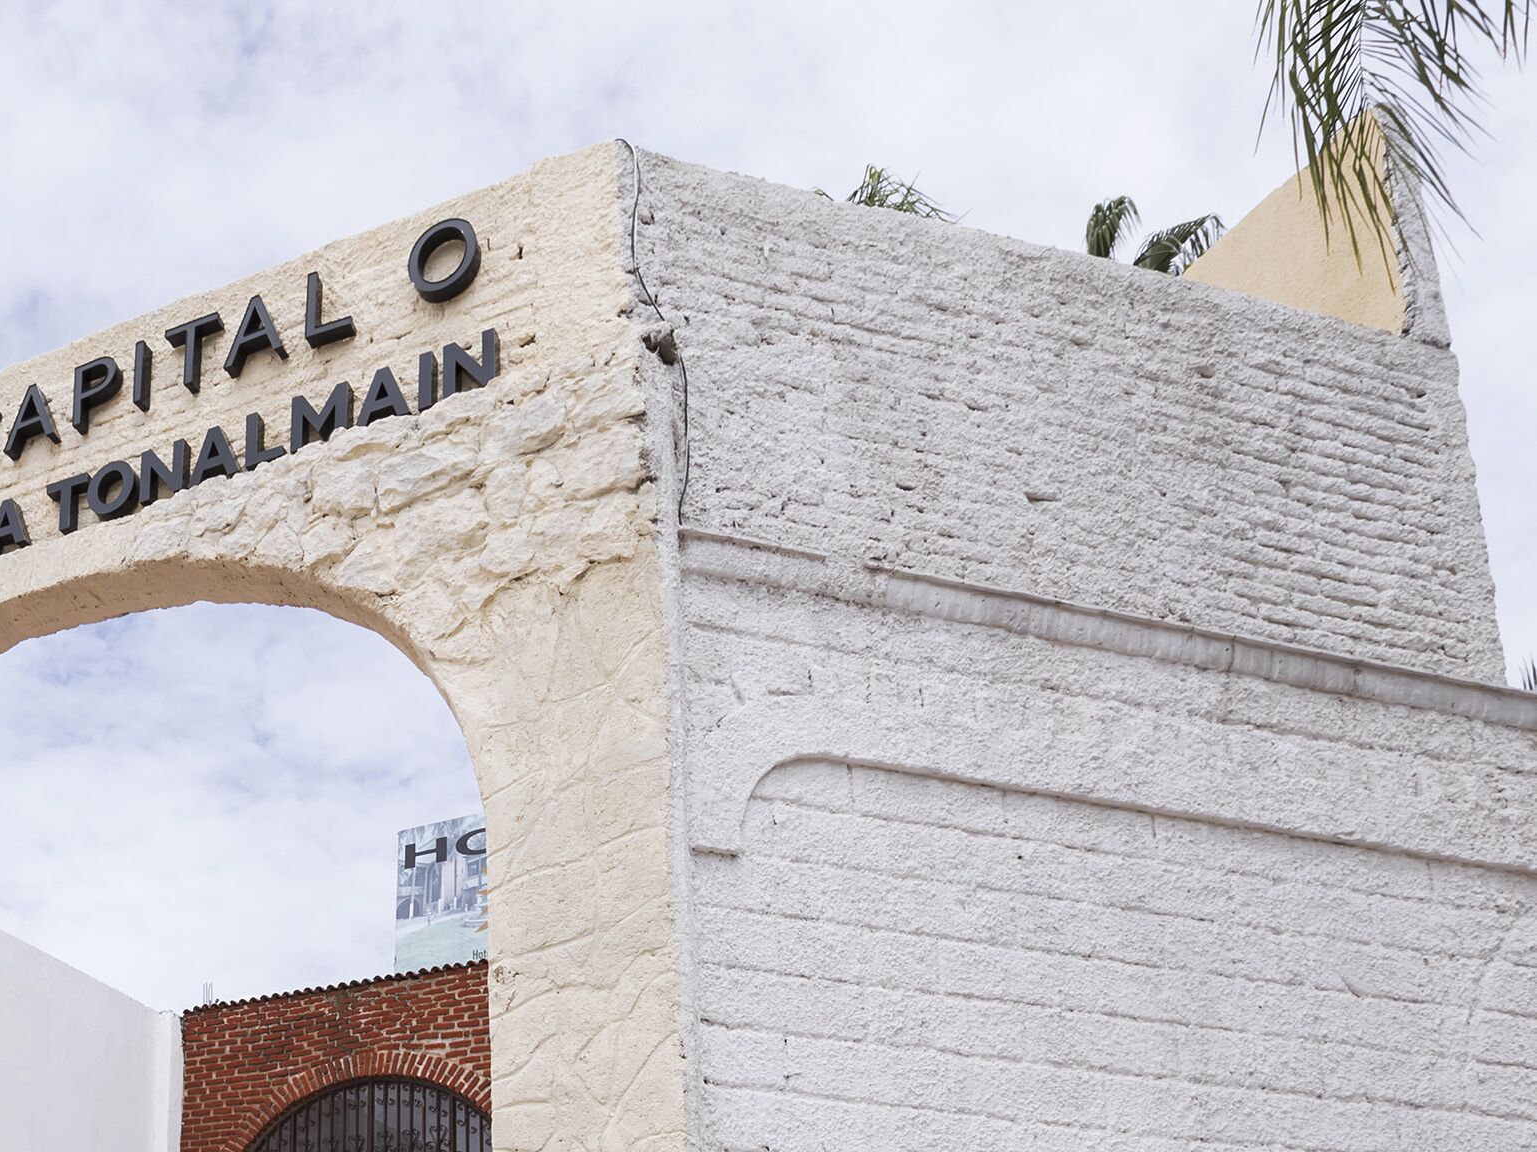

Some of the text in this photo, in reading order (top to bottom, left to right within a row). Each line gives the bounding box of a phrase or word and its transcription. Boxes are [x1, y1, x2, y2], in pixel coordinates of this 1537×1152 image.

[408, 217, 482, 304] O
[46, 328, 501, 536] TONALMAIN
[472, 949, 488, 959] Hot
